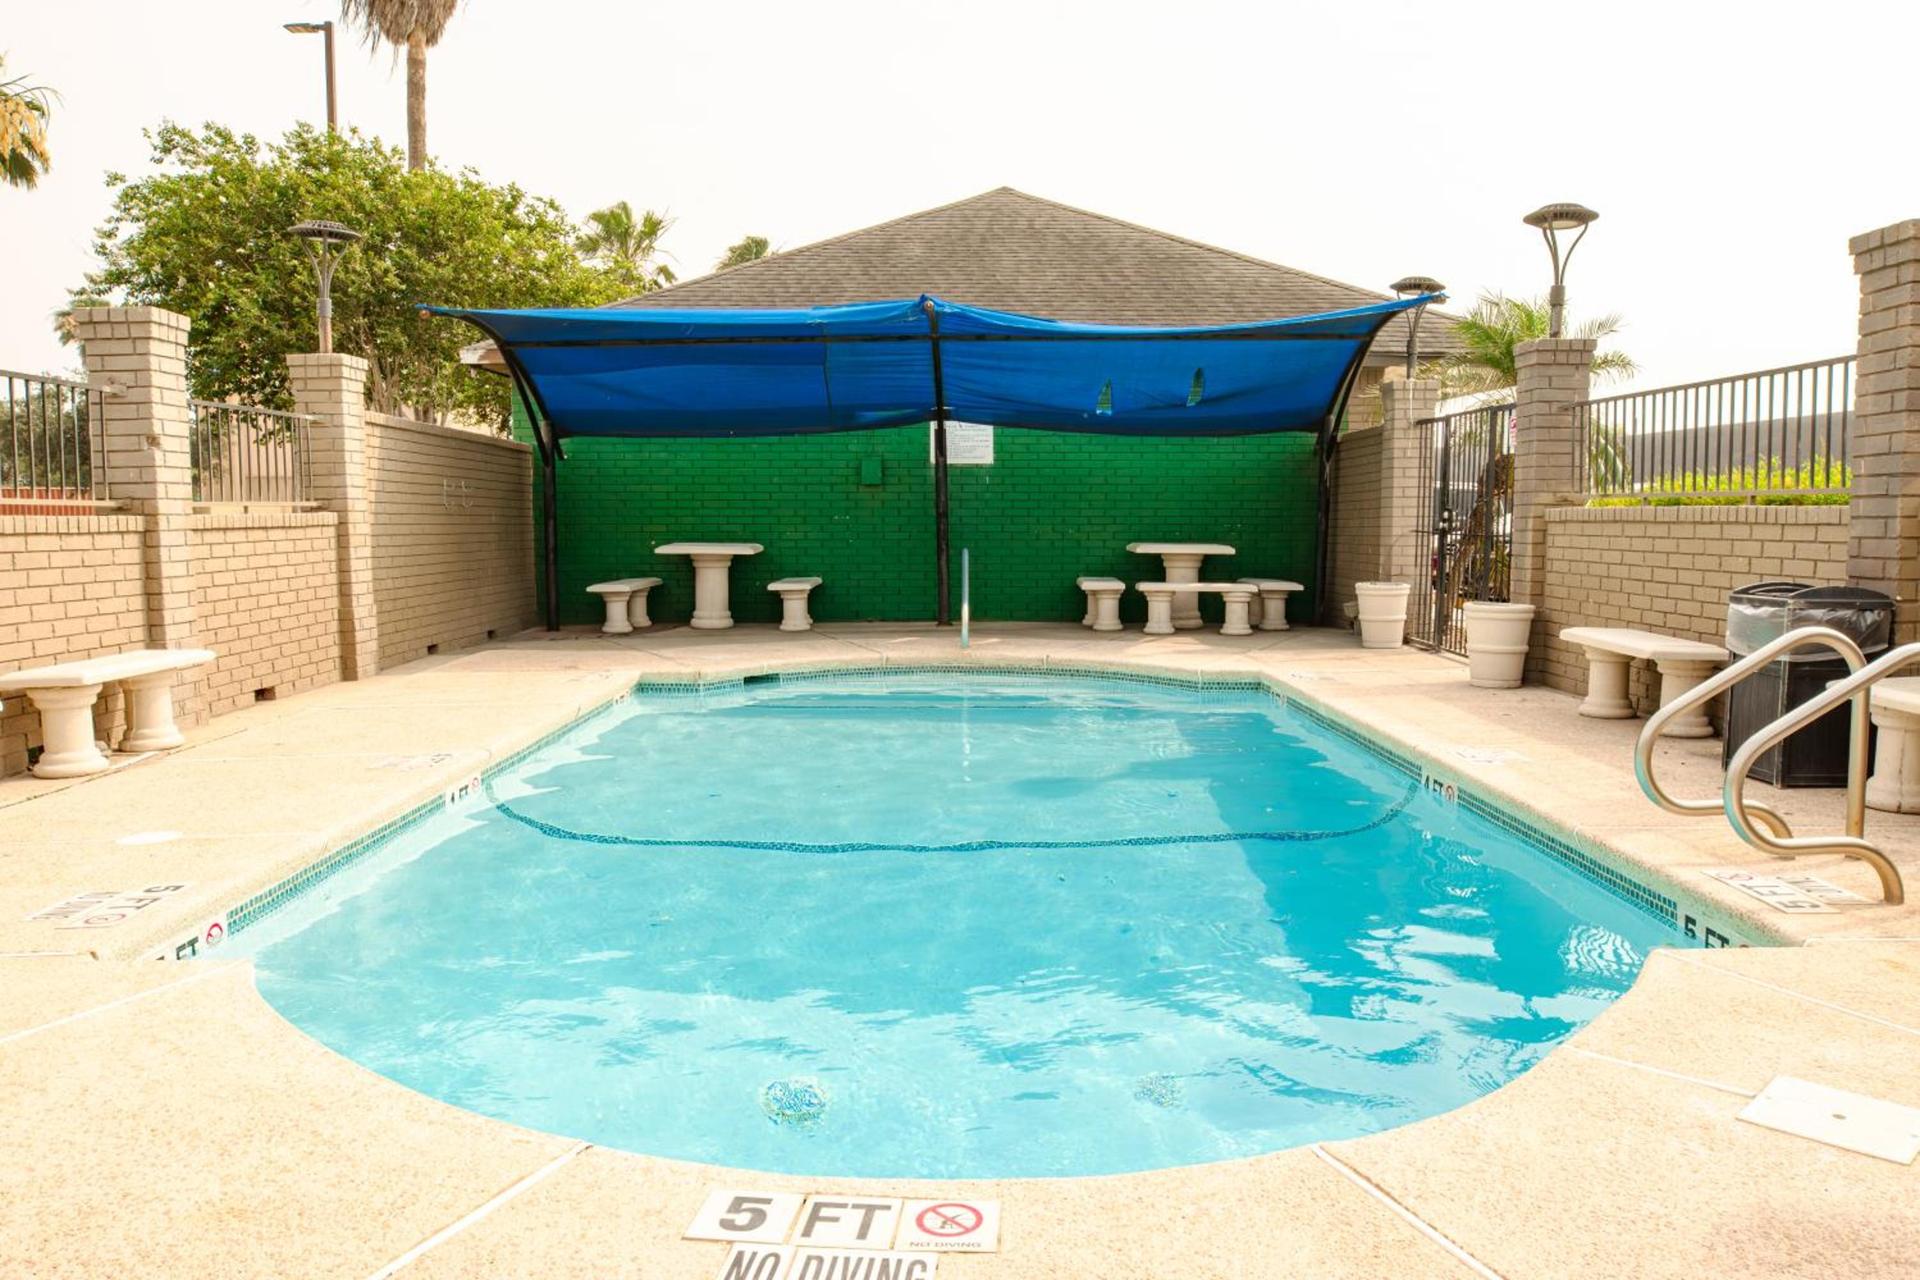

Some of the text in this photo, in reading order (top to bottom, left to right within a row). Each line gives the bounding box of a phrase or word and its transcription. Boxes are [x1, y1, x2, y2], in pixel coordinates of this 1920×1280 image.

[1684, 914, 1730, 949] 5 FT
[718, 1196, 893, 1241] 5 FT
[909, 1240, 982, 1249] NO DIVING
[723, 1249, 782, 1280] NO
